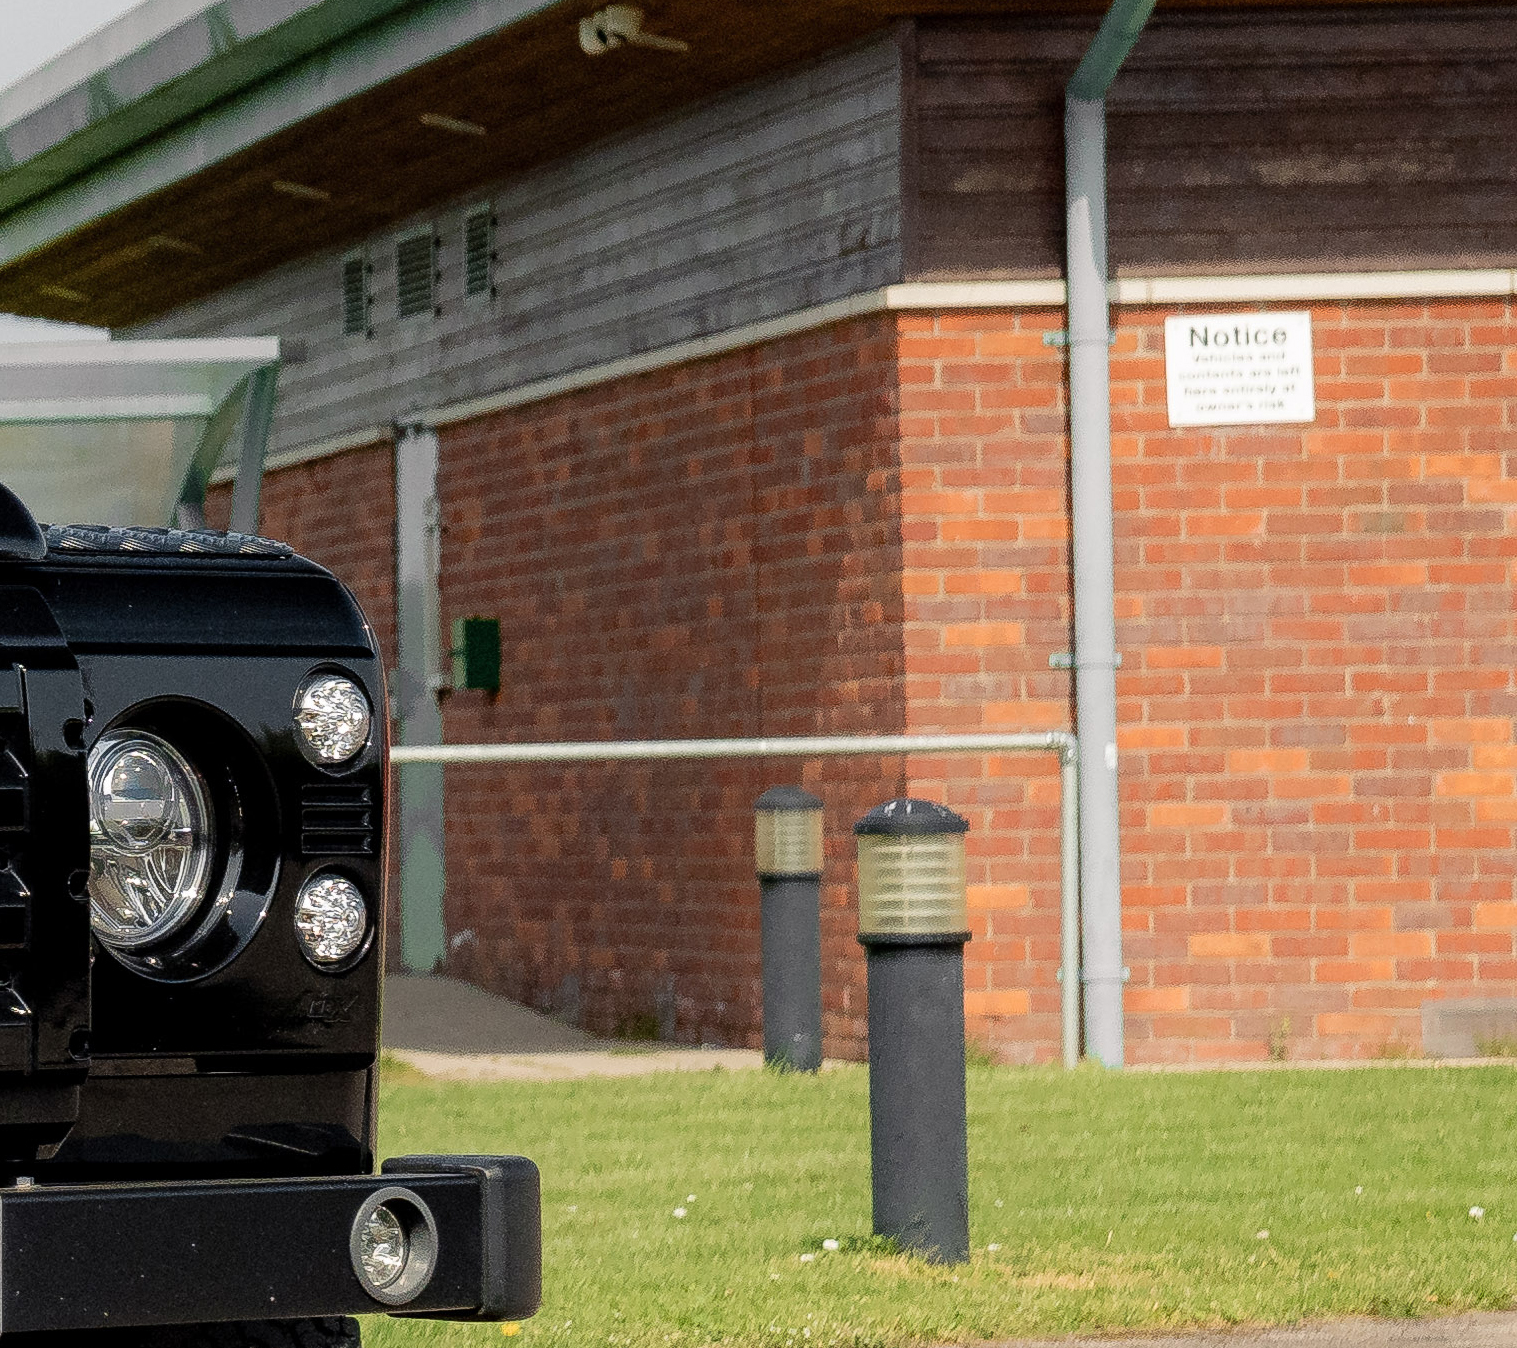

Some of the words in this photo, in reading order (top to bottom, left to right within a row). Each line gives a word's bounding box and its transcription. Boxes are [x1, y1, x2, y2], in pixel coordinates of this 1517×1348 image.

[1189, 325, 1287, 347] Notice
[1193, 351, 1253, 363] Vehicles
[1259, 350, 1286, 361] and
[1179, 369, 1243, 381] contents
[1249, 368, 1271, 378] are
[1277, 365, 1300, 376] left
[1184, 386, 1217, 397] here
[1222, 384, 1277, 396] entirely
[1282, 383, 1296, 393] at
[1258, 400, 1285, 410] risk
